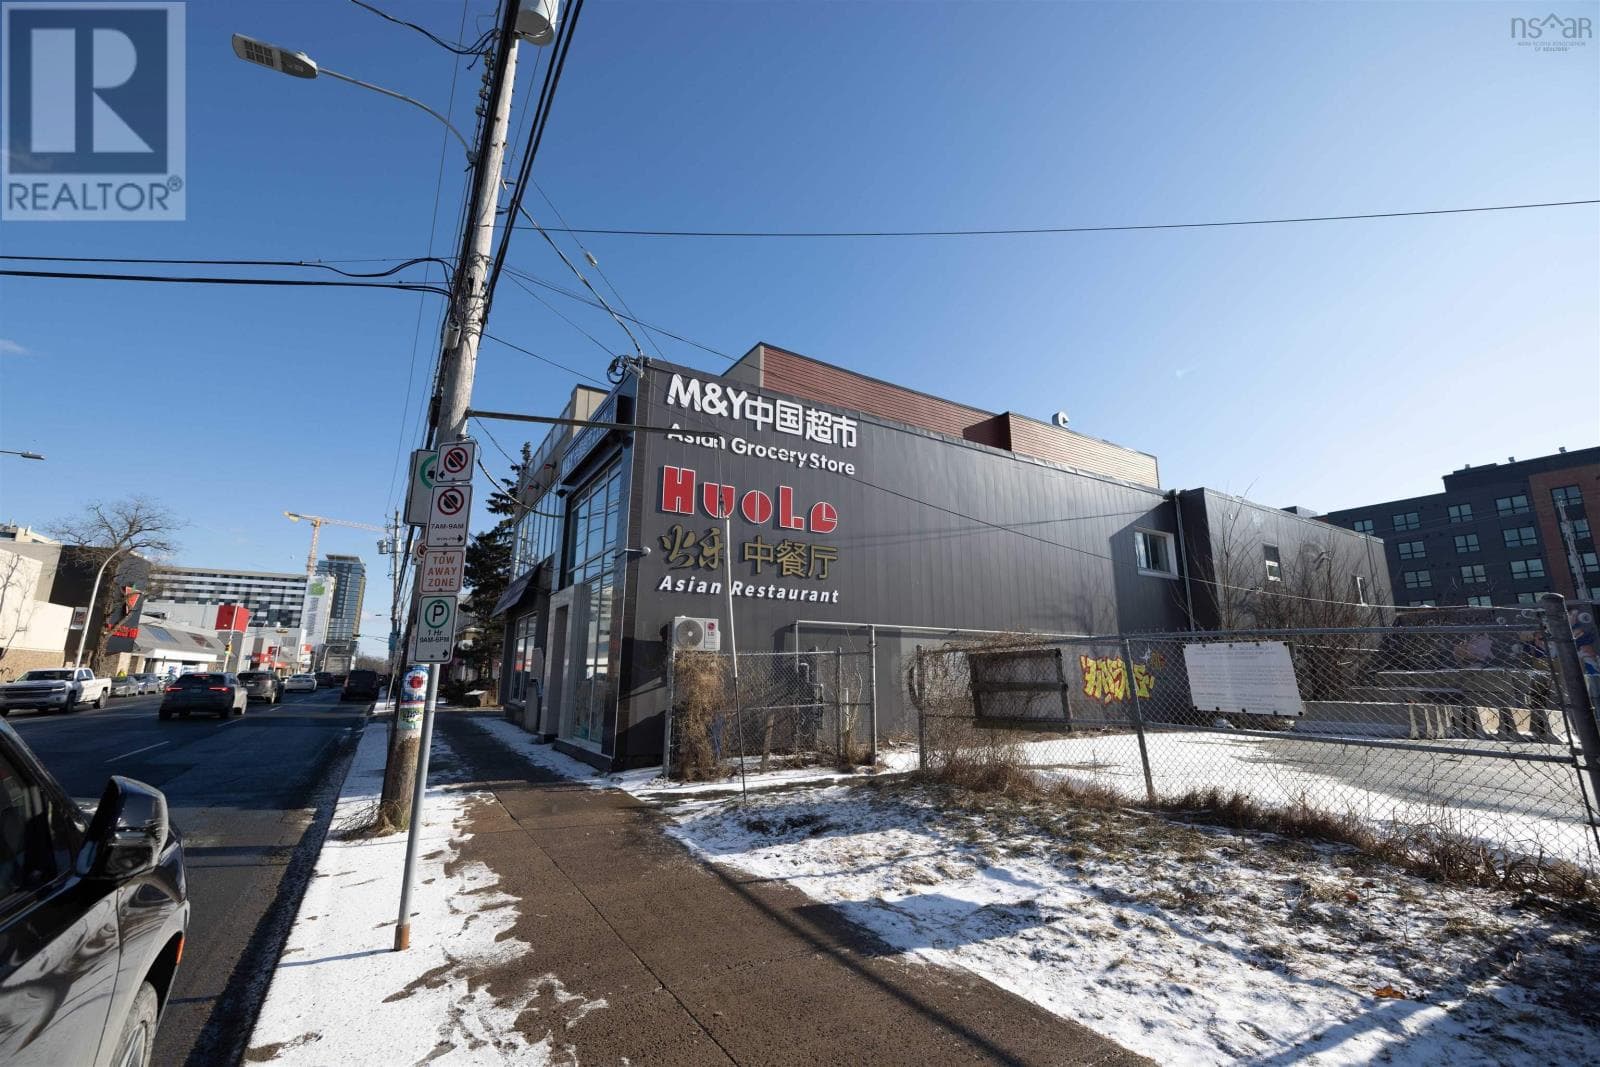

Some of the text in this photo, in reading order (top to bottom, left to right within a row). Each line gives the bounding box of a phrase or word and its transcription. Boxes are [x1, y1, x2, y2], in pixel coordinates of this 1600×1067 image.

[667, 423, 725, 450] Asian
[433, 556, 455, 564] TOW
[427, 567, 457, 575] AWAY
[428, 578, 454, 587] ZONE
[659, 575, 839, 603] Asian Restaurant
[432, 604, 445, 622] P
